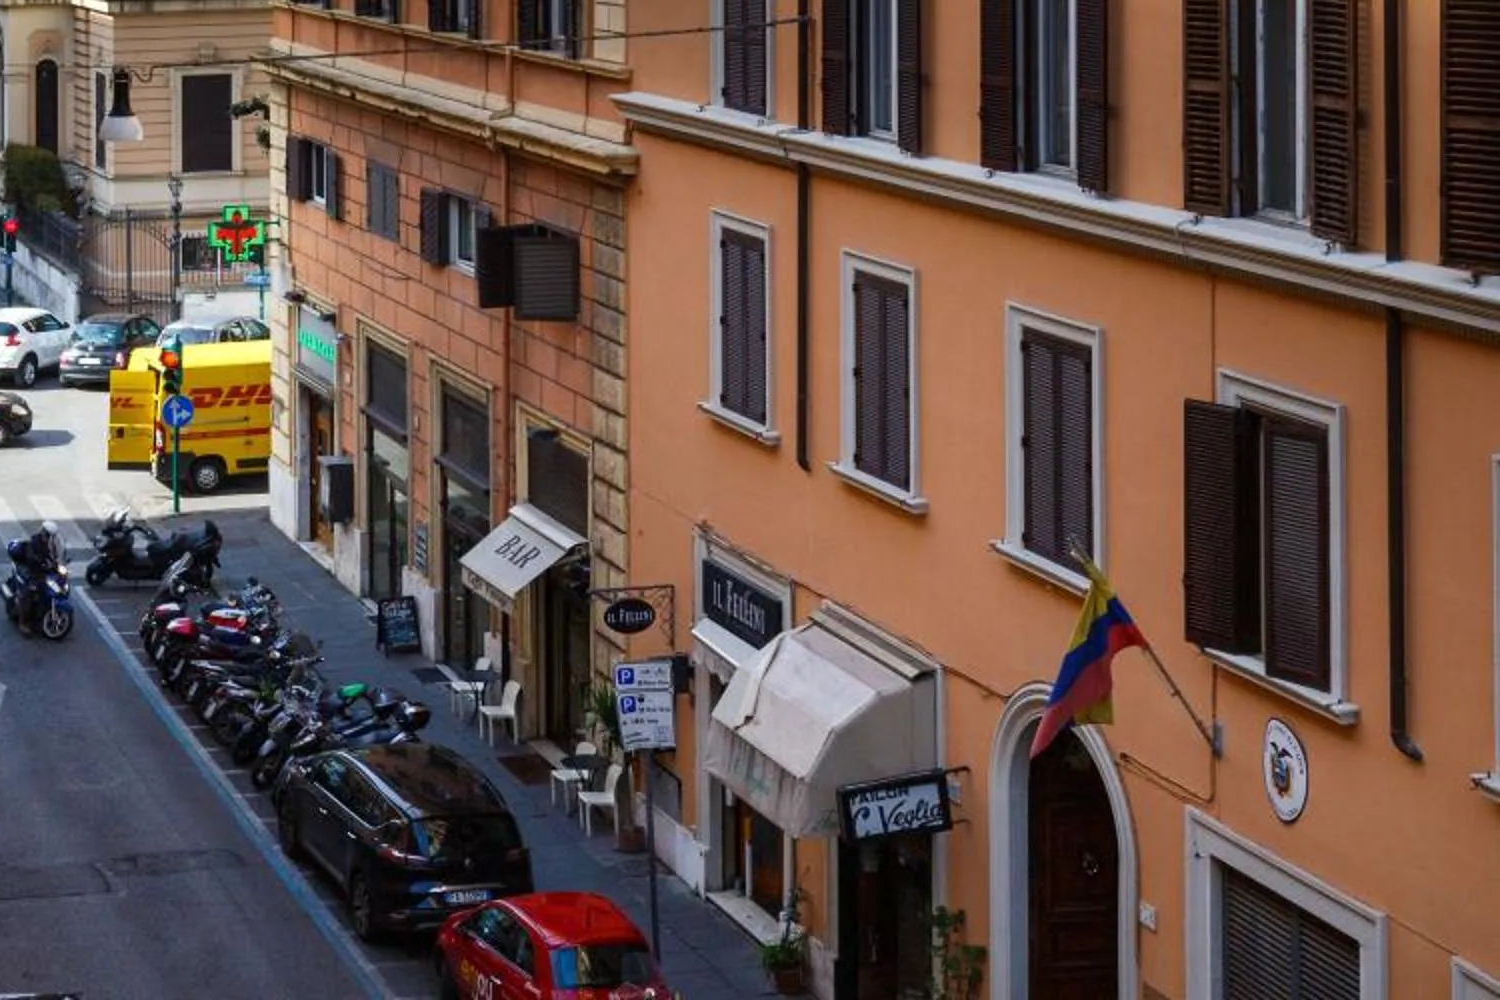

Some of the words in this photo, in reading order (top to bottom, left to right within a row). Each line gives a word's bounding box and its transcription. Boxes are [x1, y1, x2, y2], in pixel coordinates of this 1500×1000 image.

[494, 535, 541, 569] BAR
[712, 581, 722, 609] IL
[621, 670, 631, 684] P
